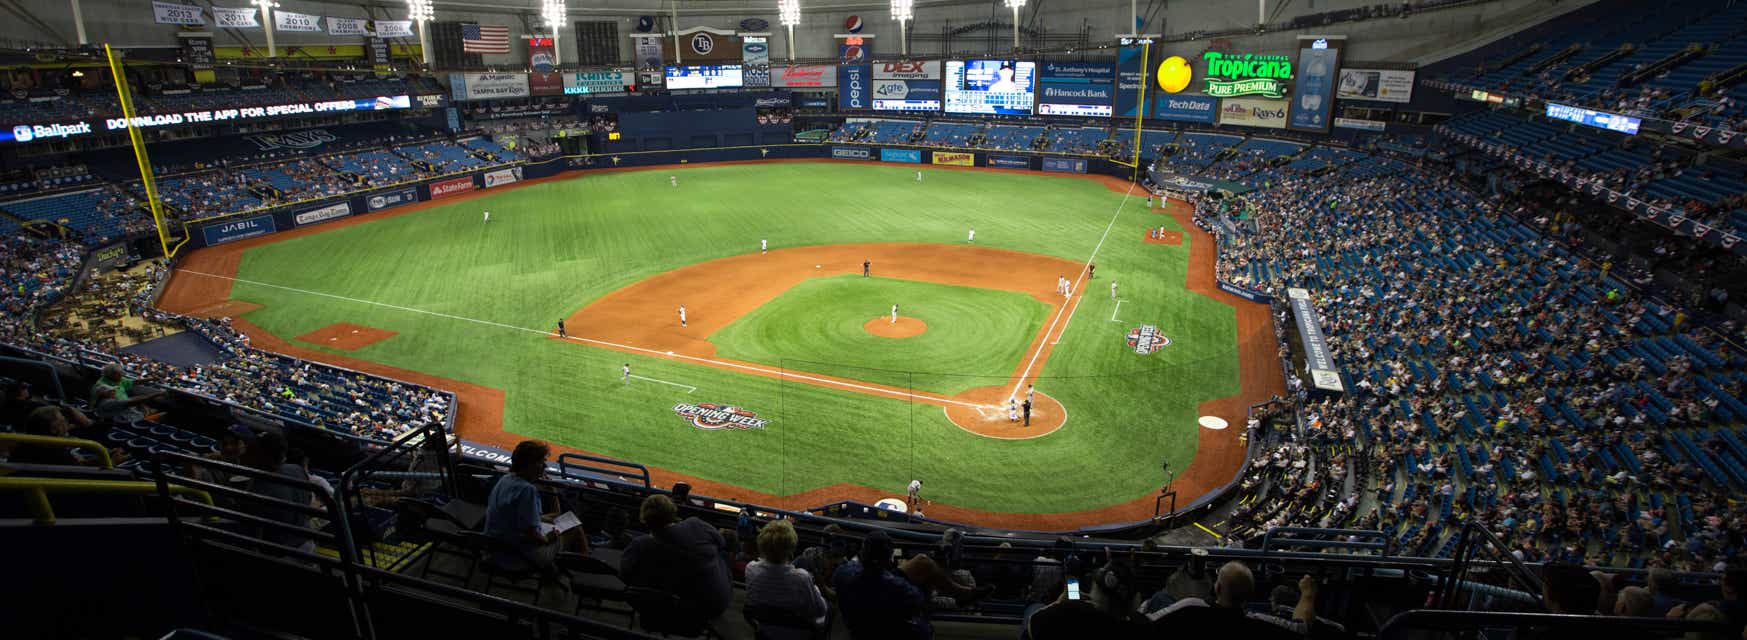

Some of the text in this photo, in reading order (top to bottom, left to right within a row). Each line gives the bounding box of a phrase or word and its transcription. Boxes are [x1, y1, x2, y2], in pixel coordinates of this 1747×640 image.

[167, 10, 193, 18] 2013
[286, 18, 310, 26] 2010
[1203, 51, 1291, 80] Tropicana
[848, 69, 862, 108] pepsi
[1054, 88, 1108, 97] Hancock Bank
[1209, 82, 1277, 94] PURE PREMIUM
[184, 111, 212, 122] THE
[214, 109, 239, 120] APP
[240, 107, 266, 119] FOR
[266, 103, 313, 115] SPECIAL
[314, 100, 356, 111] OFFERS
[1168, 99, 1210, 111] Tech Data
[33, 121, 91, 138] Ballpark
[833, 149, 868, 158] GEICO
[221, 220, 258, 233] JABIL
[1312, 343, 1328, 369] WELCOME
[674, 403, 767, 428] OPENING WEEK
